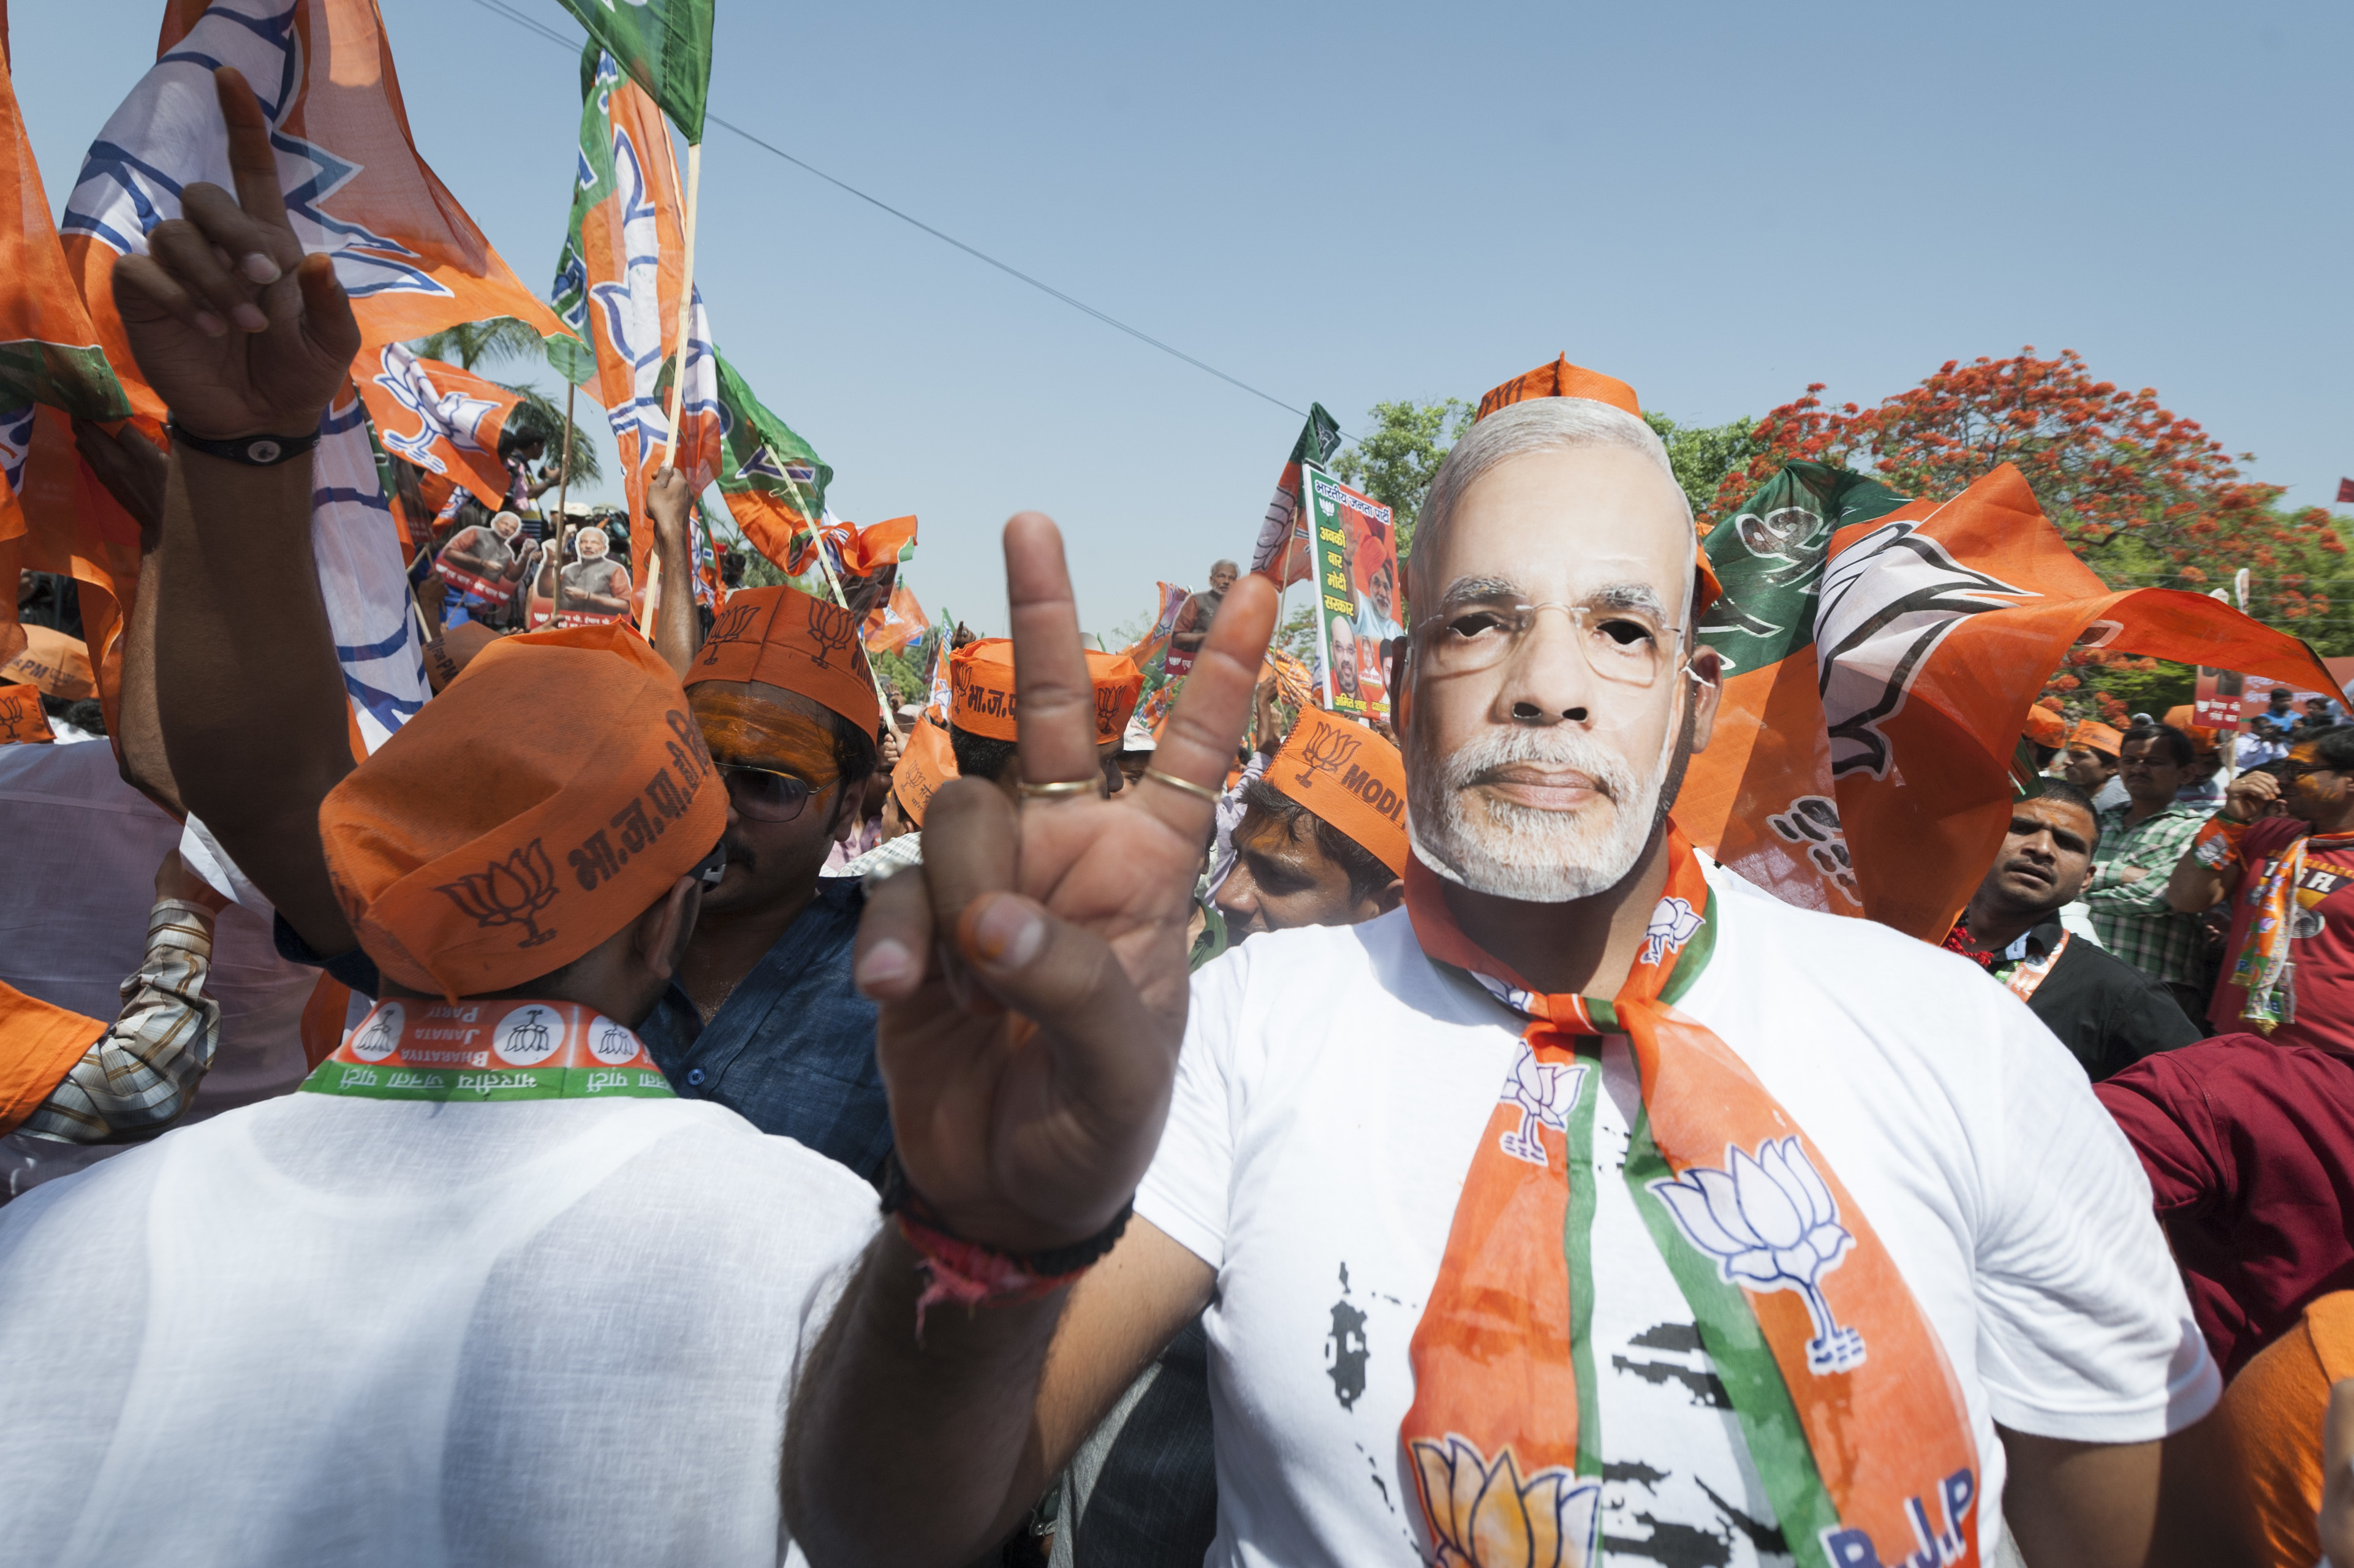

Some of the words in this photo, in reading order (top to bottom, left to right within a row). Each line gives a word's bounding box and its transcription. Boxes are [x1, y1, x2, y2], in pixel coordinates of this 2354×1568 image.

[1315, 480, 1347, 504] भारतीय
[1348, 497, 1374, 517] जनता
[1374, 506, 1391, 525] पार्टी
[1327, 570, 1347, 592] मोदी
[1324, 594, 1354, 616] सरकार
[20, 659, 48, 678] PM
[967, 684, 1018, 721] भा.ज.प
[1334, 693, 1354, 708] अमित
[1355, 700, 1368, 711] शाह
[1341, 763, 1405, 820] MODI
[414, 1028, 480, 1044] JANATA
[400, 1047, 488, 1067] BHARATIYA
[339, 1069, 376, 1091] पार्टी
[385, 1073, 444, 1088] जनता
[457, 1074, 536, 1093] भारतीय
[586, 1071, 627, 1093] पार्टी
